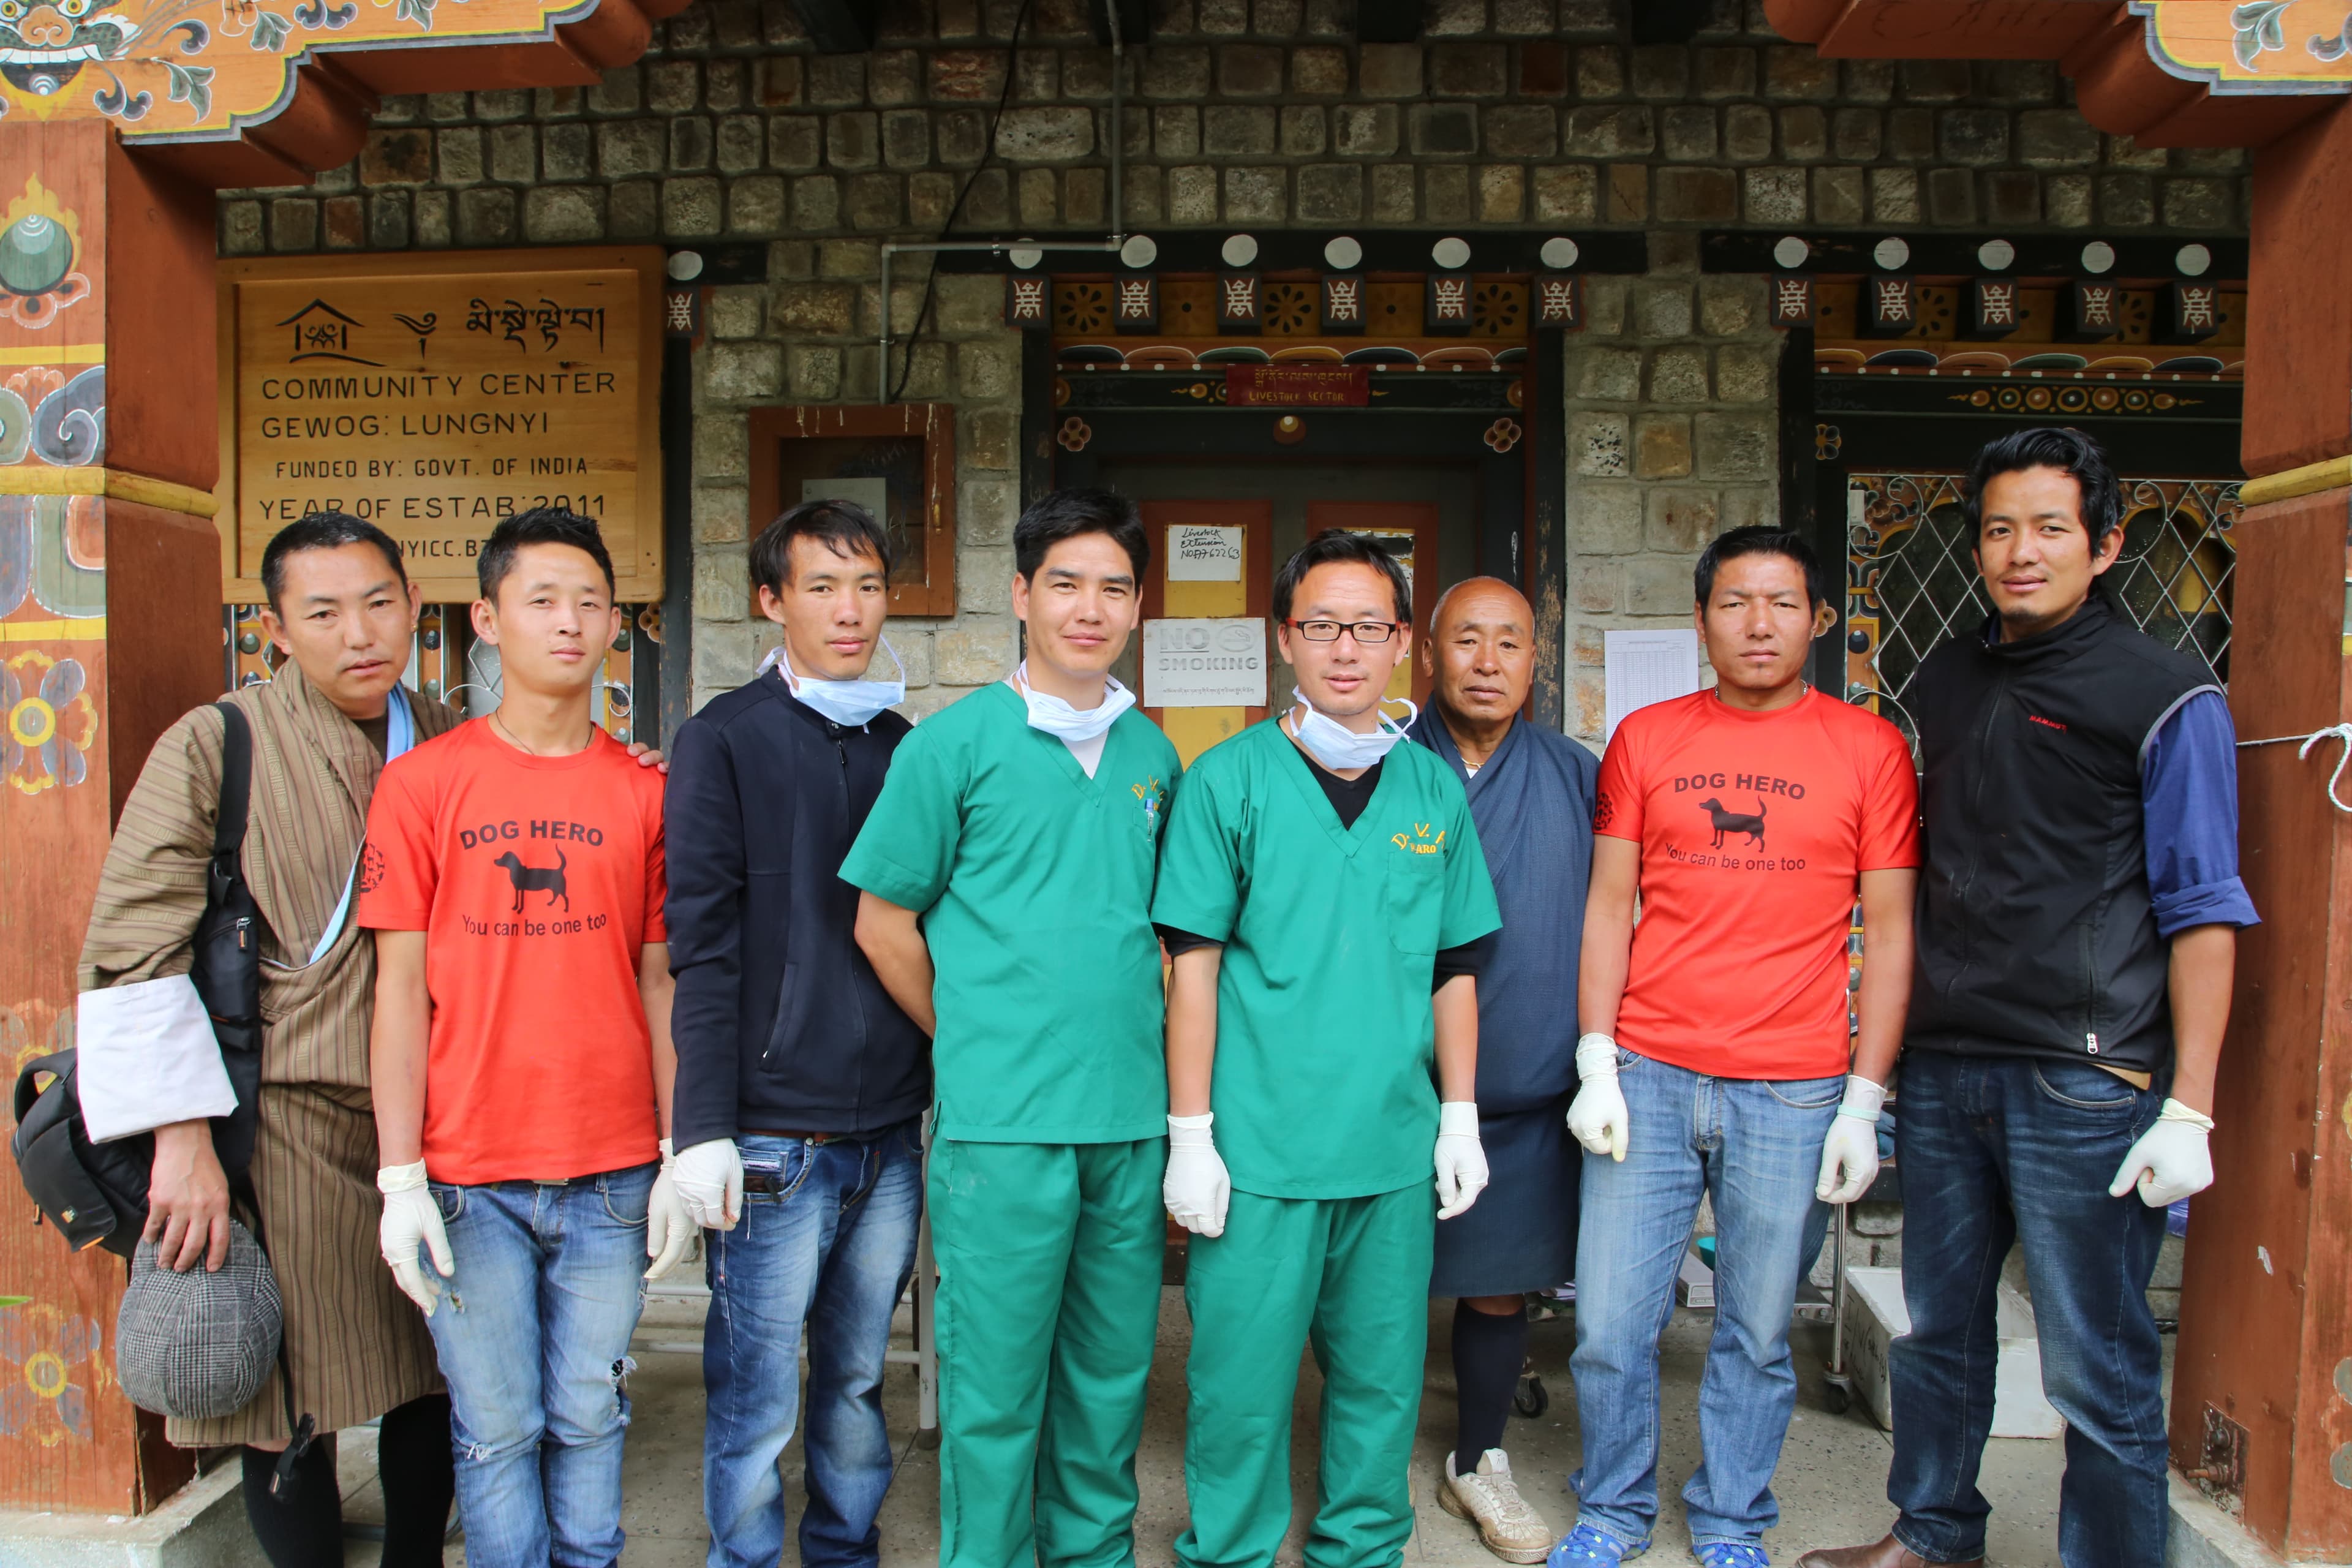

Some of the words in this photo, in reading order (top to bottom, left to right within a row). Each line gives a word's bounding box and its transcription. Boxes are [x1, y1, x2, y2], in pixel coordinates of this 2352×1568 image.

[262, 375, 462, 399] COMMUNITY
[480, 372, 615, 396] CENTER
[1308, 391, 1344, 402] SECTOR
[262, 415, 390, 439] GEWOG:
[402, 412, 548, 435] LUNGNYI
[276, 460, 358, 478] FUNDED
[369, 459, 402, 478] BY:
[414, 458, 480, 477] GOVT.
[492, 458, 518, 476] OF
[530, 457, 587, 475] INDIA
[260, 498, 344, 520] YEAR
[356, 497, 391, 519] OF
[1159, 627, 1211, 650] NO
[1158, 657, 1259, 671] SMOKING
[1674, 772, 1726, 793] DOG
[1735, 773, 1806, 800] HERO
[459, 820, 520, 851] DOG
[530, 820, 604, 847] HERO
[1665, 842, 1687, 862] You
[1690, 853, 1716, 867] can
[1721, 854, 1740, 870] be
[1745, 859, 1775, 871] one
[1781, 857, 1806, 871] too
[462, 914, 488, 937] You
[494, 922, 519, 937] can
[524, 919, 546, 937] be
[551, 919, 582, 935] one
[586, 913, 606, 930] too
